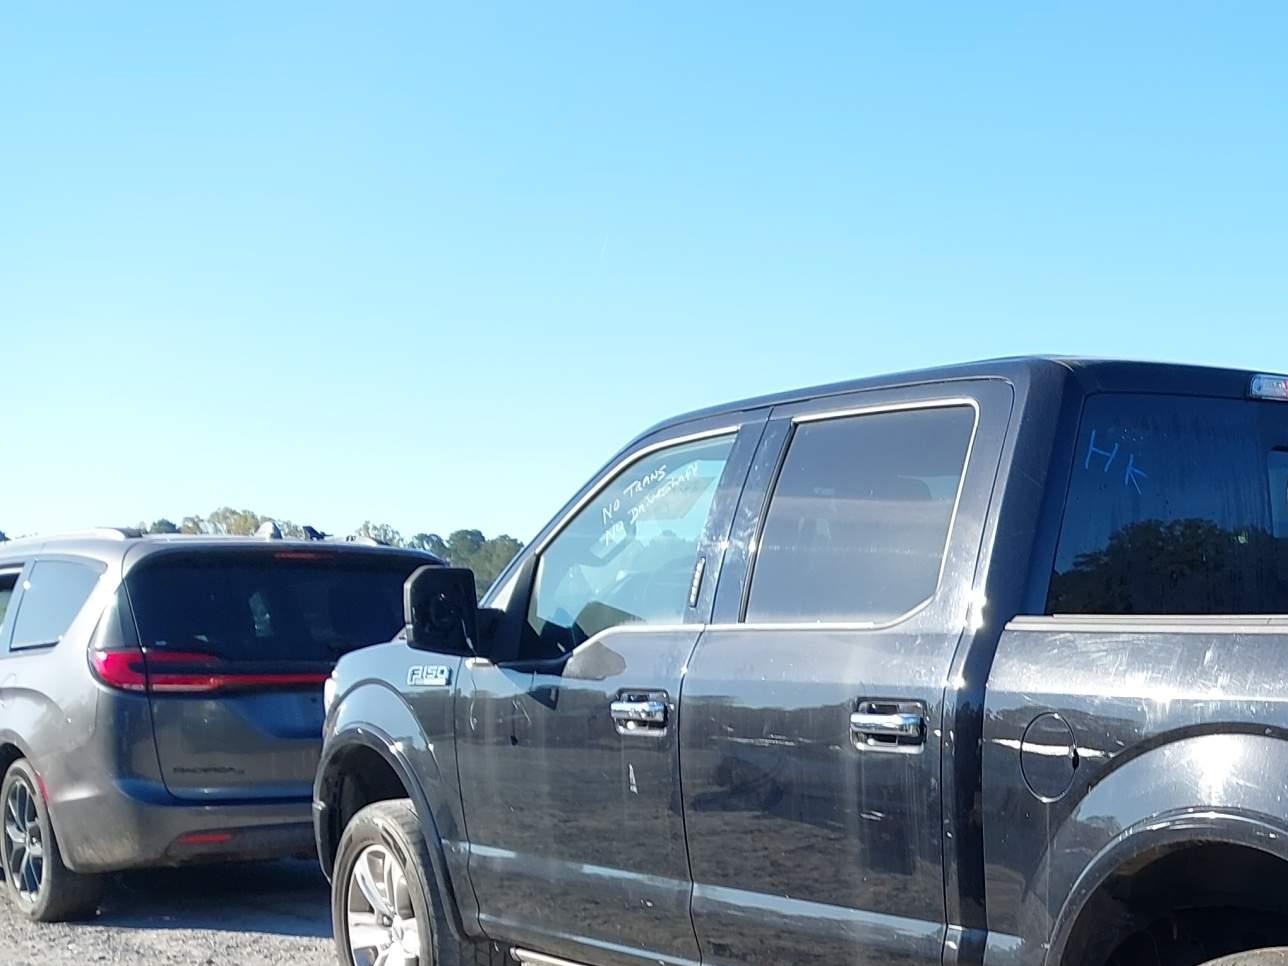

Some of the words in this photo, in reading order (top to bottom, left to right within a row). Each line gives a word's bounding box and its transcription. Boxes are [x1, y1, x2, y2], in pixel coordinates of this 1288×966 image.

[602, 498, 620, 526] NO
[623, 464, 667, 498] TRANS
[604, 520, 624, 547] NO
